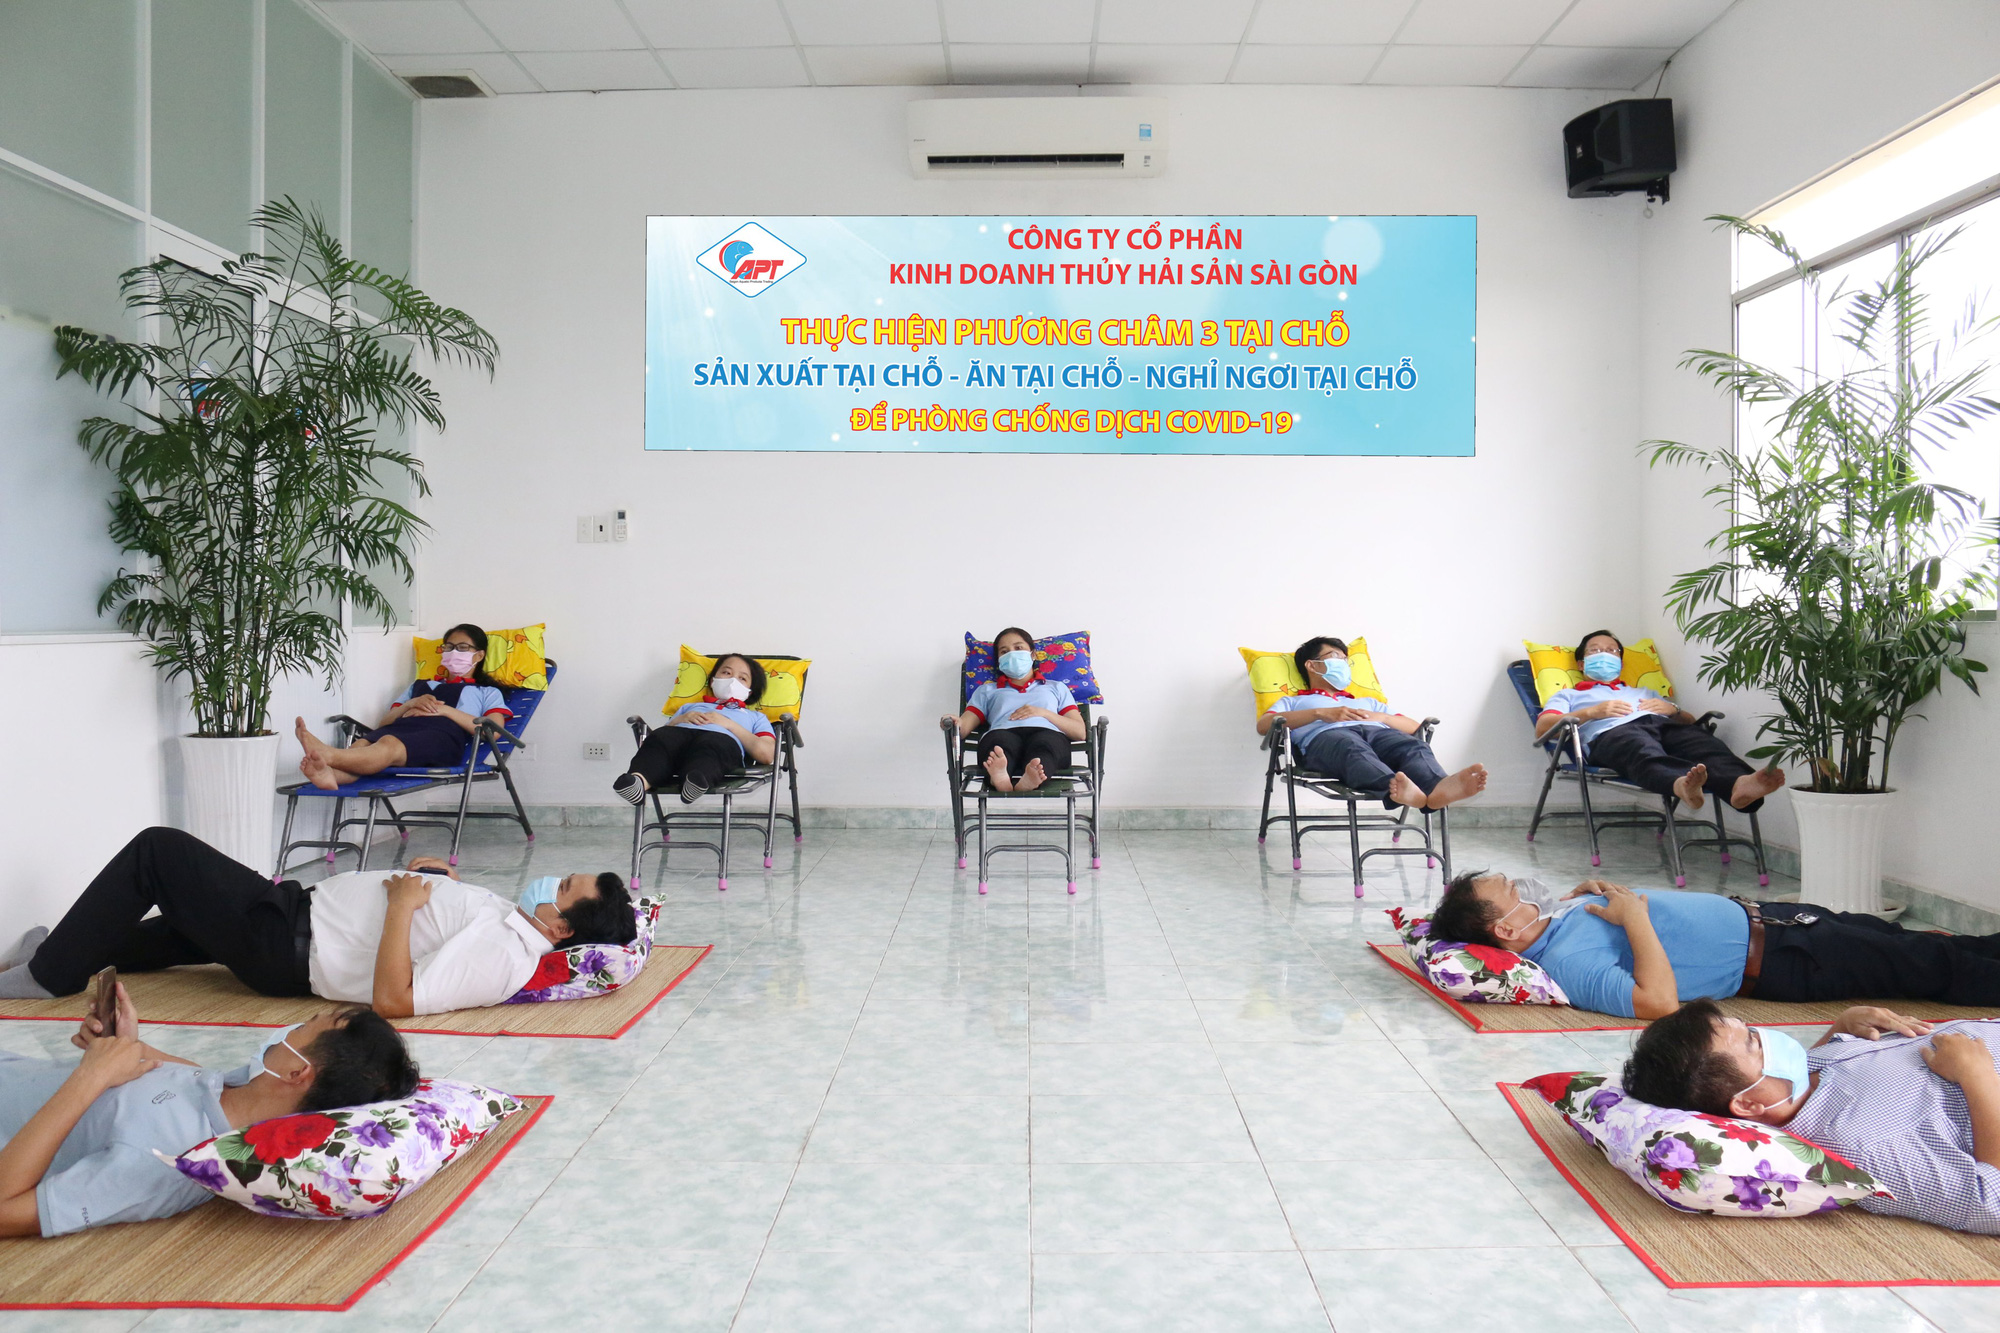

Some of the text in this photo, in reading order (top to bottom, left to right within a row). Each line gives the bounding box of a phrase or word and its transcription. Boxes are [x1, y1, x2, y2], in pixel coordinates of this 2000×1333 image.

[1008, 220, 1242, 250] CÔNG TY CỔ PHẦN
[731, 260, 784, 280] APT
[890, 256, 1358, 286] KINH DOANH THỦY HẢI SẢN SÀI GÒN
[780, 309, 1350, 355] THỰC HIỆN PHƯƠNG CHÂM 3 TẠI CHỖ
[694, 356, 749, 387] SẢN
[756, 356, 829, 387] XUẤT
[833, 363, 875, 394] TẠI
[881, 355, 943, 388] CHỖ
[965, 359, 1005, 388] ĂN
[1011, 364, 1054, 395] TẠI
[1061, 356, 1123, 389] CHỖ
[1146, 358, 1218, 389] NGHỈ
[1225, 363, 1297, 390] NGƠI
[1303, 365, 1347, 396] TẠI
[1354, 357, 1418, 390] CHỖ
[849, 400, 1294, 440] ĐỂ PHÒNG CHỐNG DỊCH COVID-19
